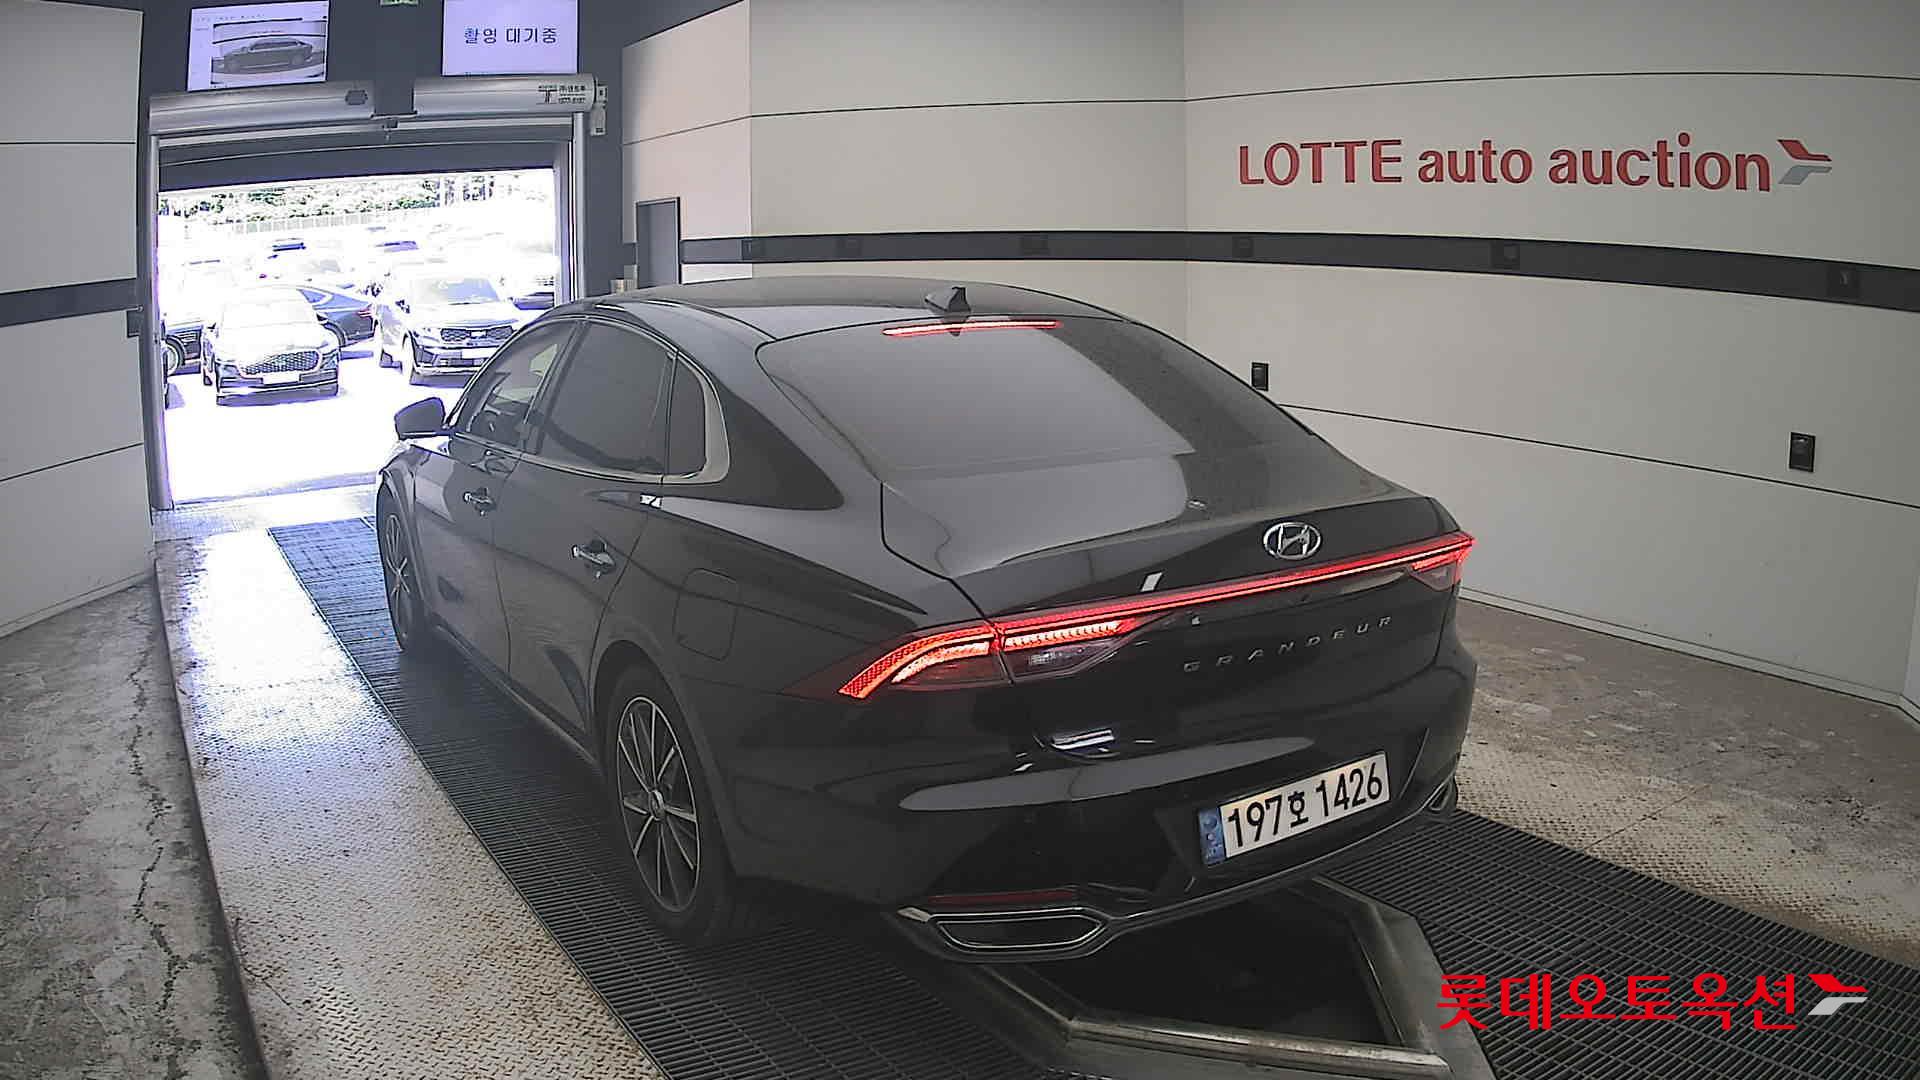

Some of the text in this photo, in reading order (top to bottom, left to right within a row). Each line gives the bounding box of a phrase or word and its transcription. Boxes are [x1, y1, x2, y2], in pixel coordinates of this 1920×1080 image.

[505, 27, 557, 44] 대기중
[1238, 131, 1772, 193] LOTTE auto auction
[1183, 616, 1391, 672] GRANDEUR
[1228, 762, 1383, 848] 197호 1426
